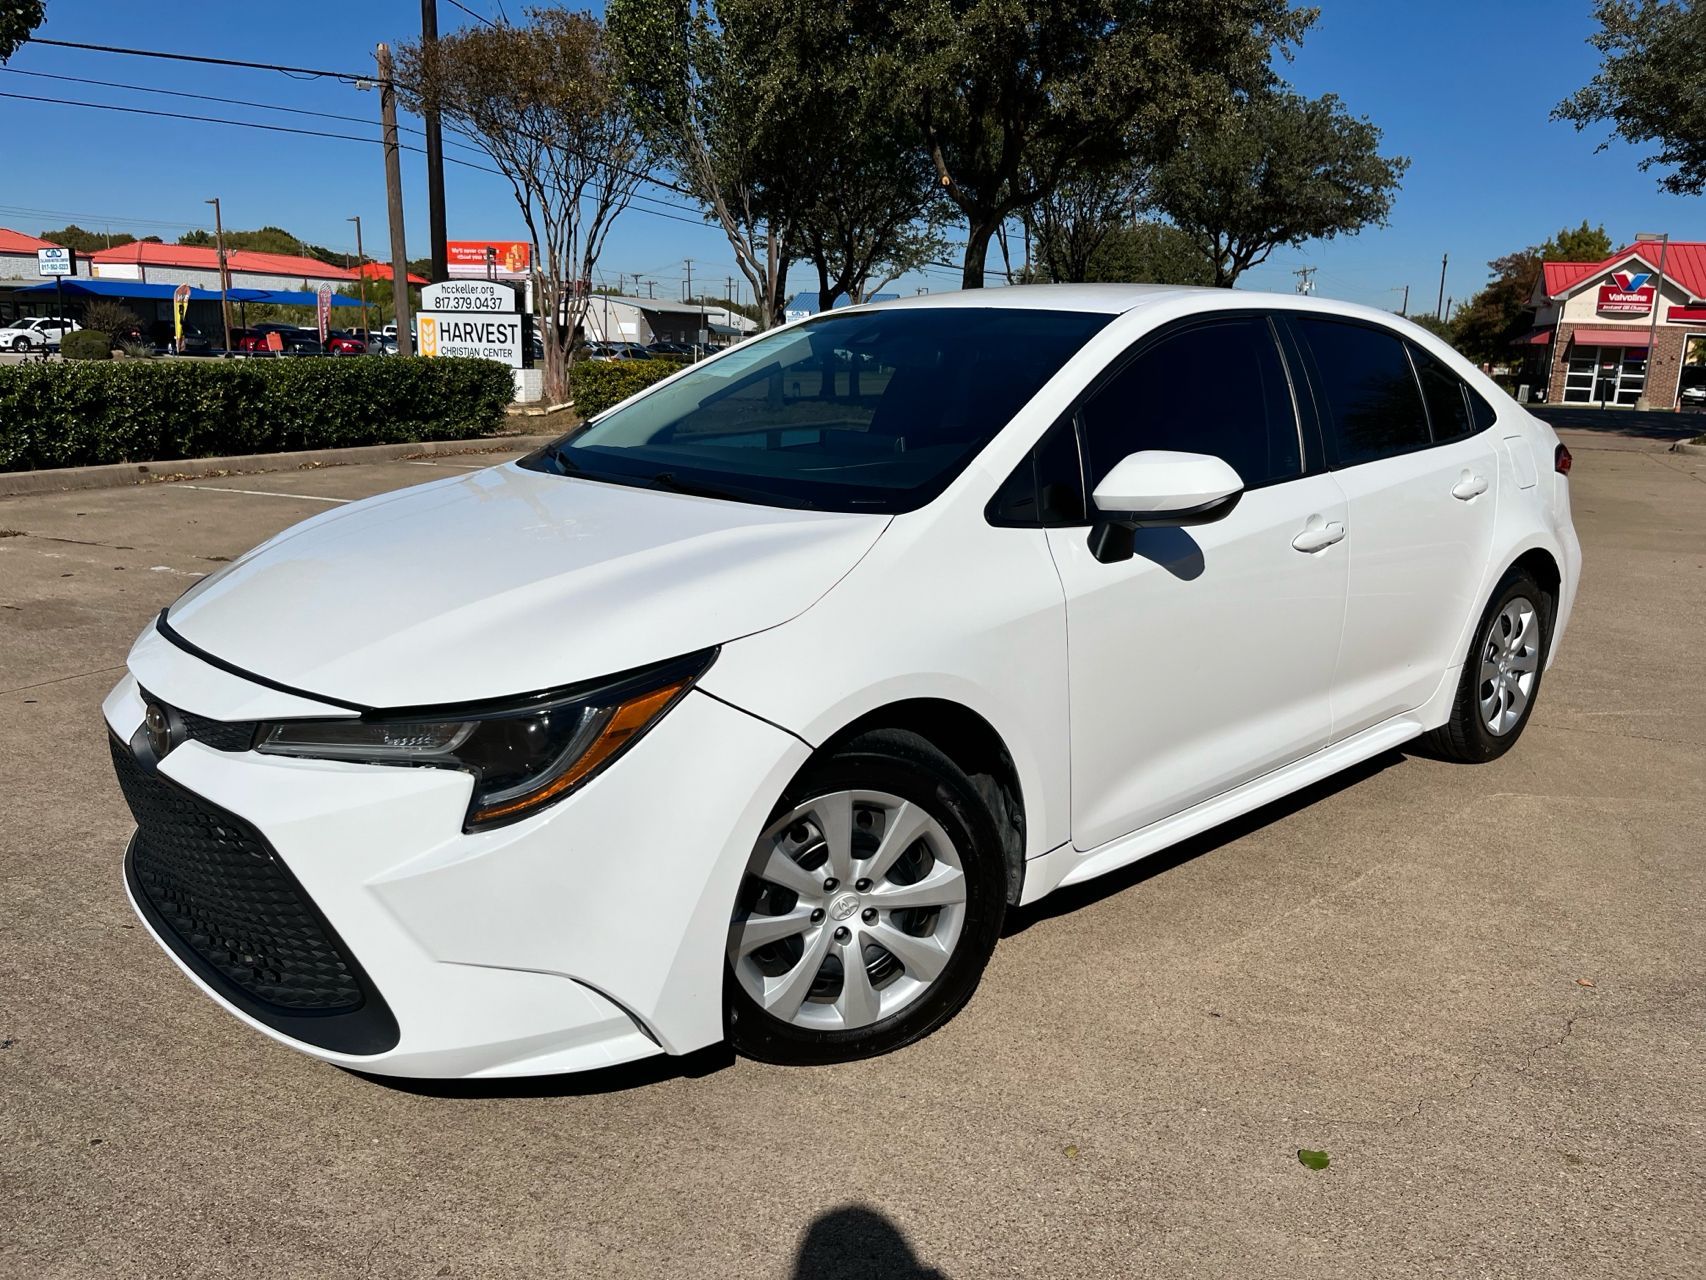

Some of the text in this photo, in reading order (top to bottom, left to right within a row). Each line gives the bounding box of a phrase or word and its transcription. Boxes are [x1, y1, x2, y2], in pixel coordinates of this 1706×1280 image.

[441, 284, 494, 296] hcckeller.org
[434, 297, 503, 310] 817.379.0437
[1608, 293, 1648, 302] Valvoline
[440, 322, 518, 344] HARVEST
[441, 346, 512, 358] CHRISTIAN CENTER
